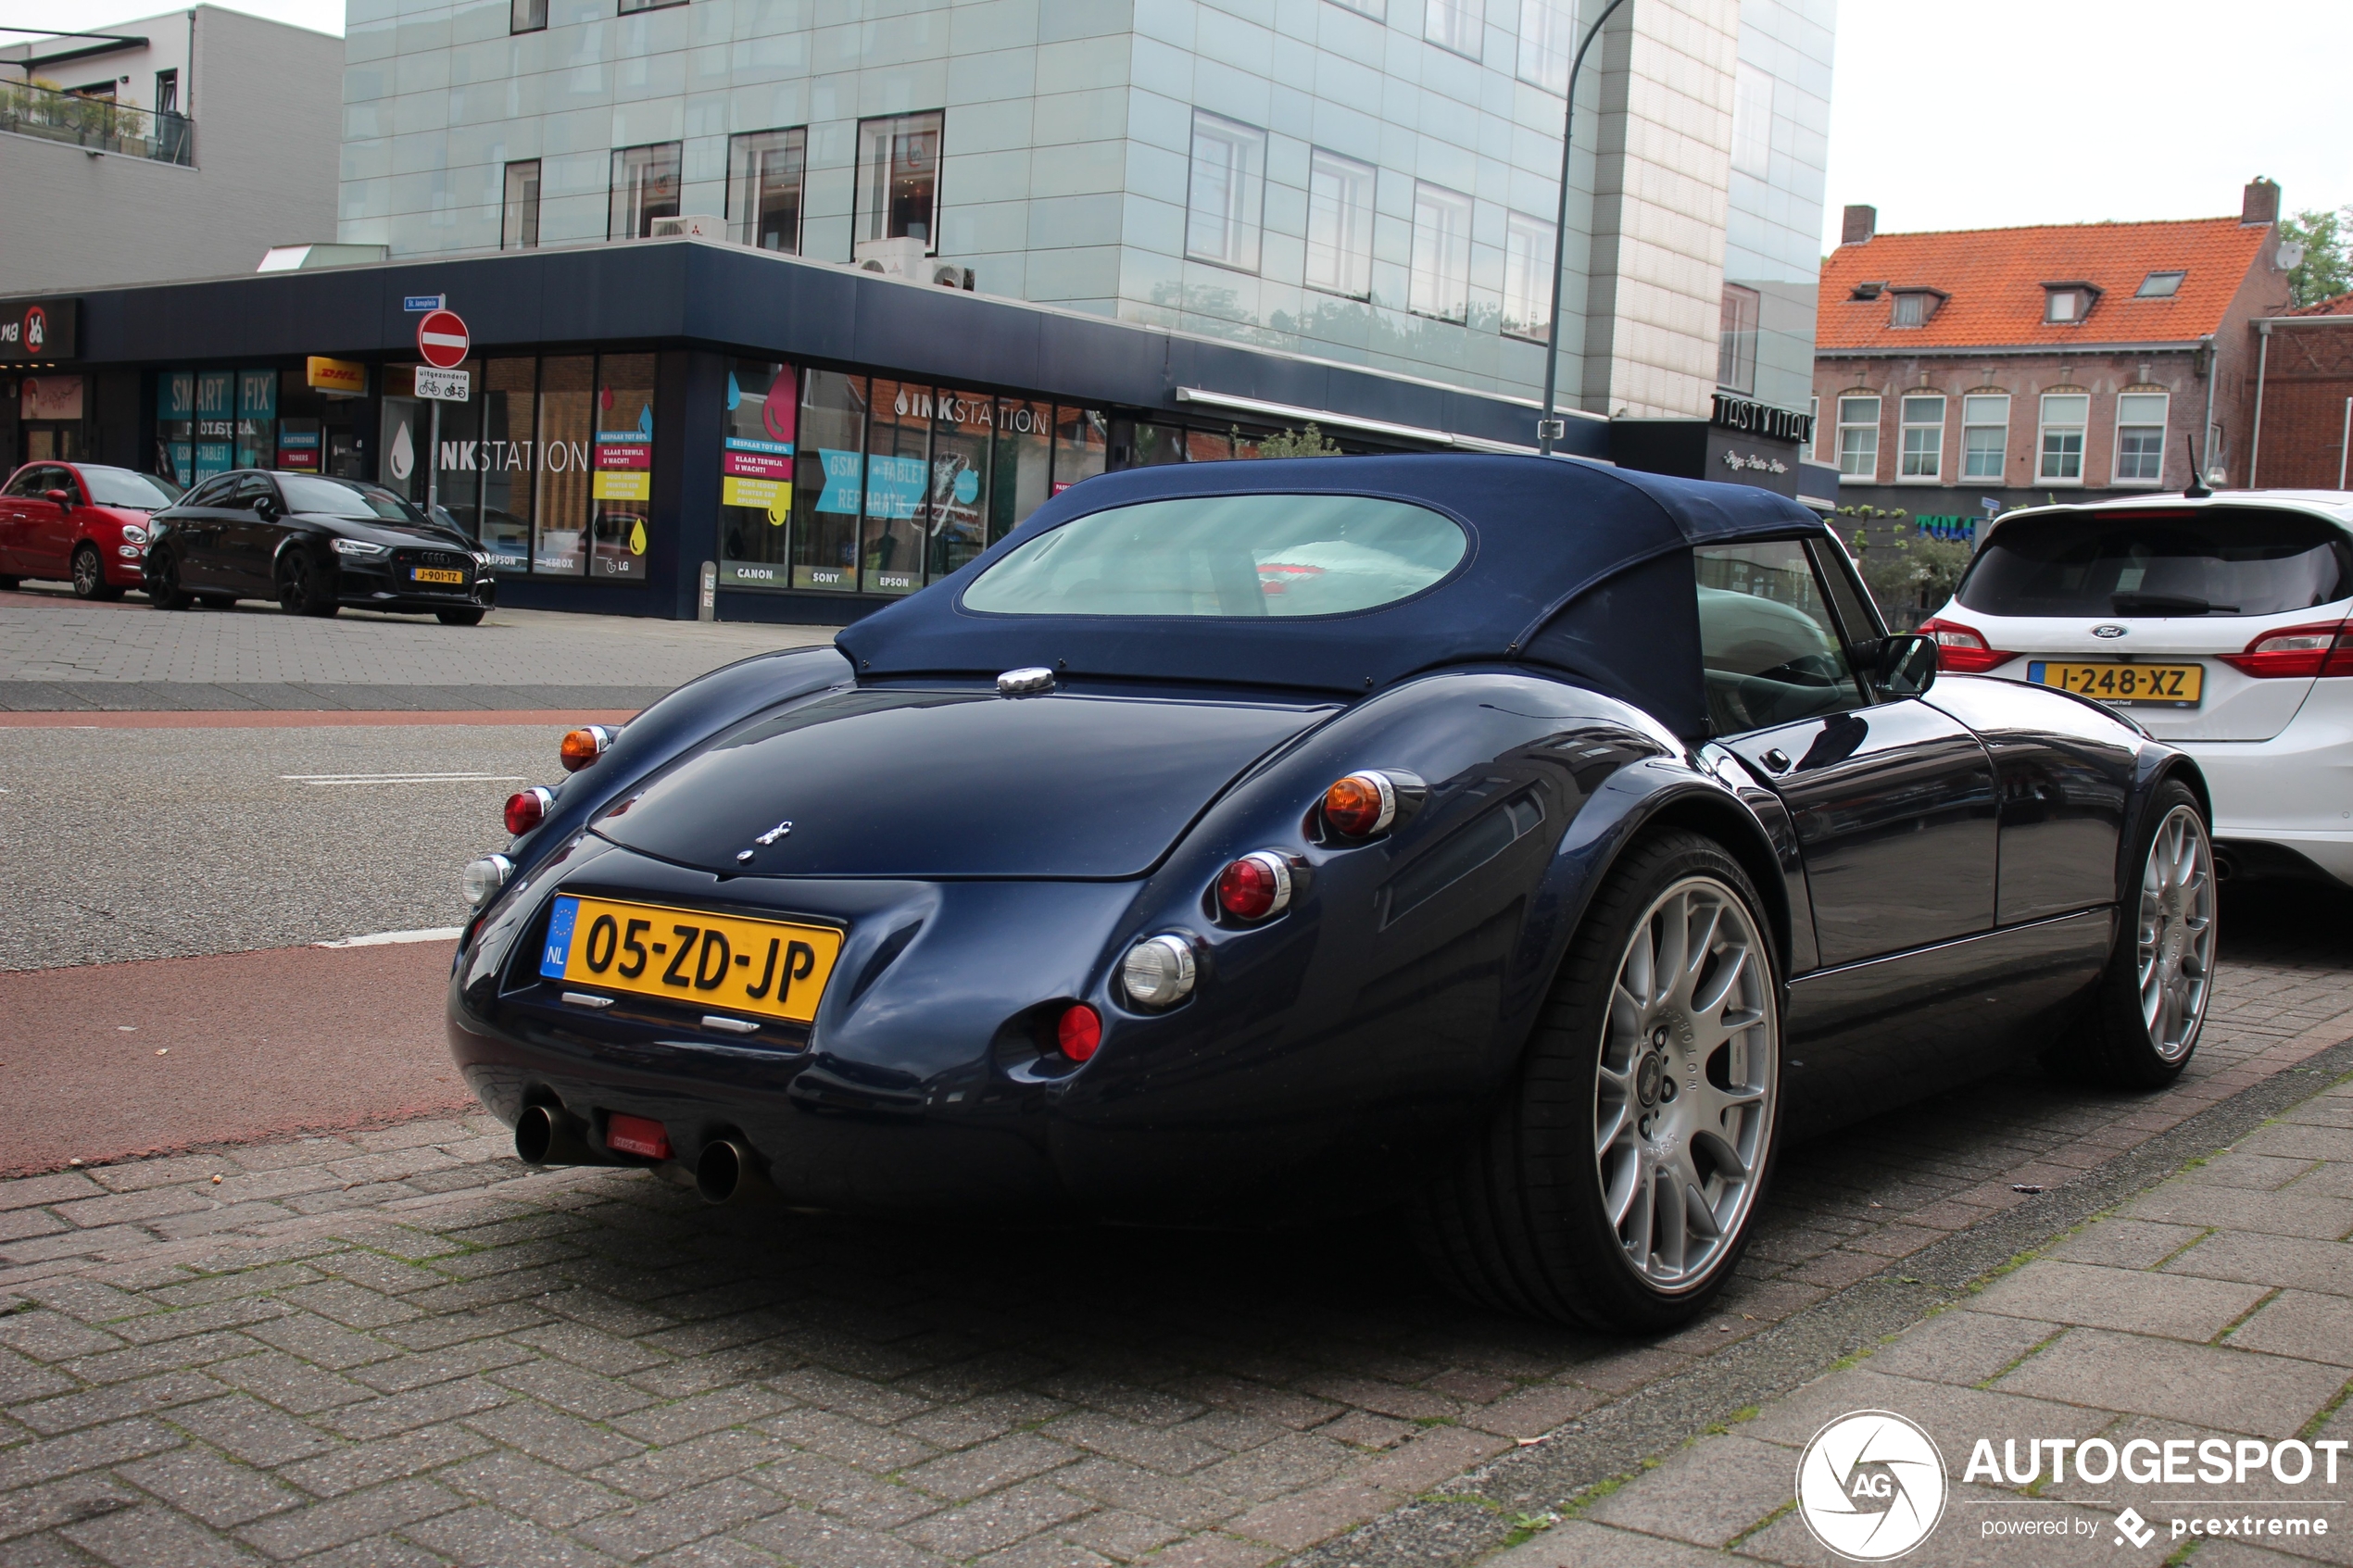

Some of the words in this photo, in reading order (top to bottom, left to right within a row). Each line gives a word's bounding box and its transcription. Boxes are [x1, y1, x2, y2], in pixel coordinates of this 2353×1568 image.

[321, 368, 358, 381] DHL
[419, 370, 467, 381] uitgezonderd
[171, 378, 225, 411] SMART
[912, 393, 1047, 435] INKSTATION
[1718, 395, 1772, 433] TASTY
[1775, 409, 1816, 443] ITALY
[732, 439, 760, 448] BESPAAR
[761, 443, 774, 451] TOT
[201, 445, 226, 461] TABLET
[288, 454, 308, 462] TONERS
[735, 455, 756, 464] KLAAR
[757, 458, 783, 467] TERWIJL
[740, 464, 766, 473] WACHT!
[830, 455, 859, 478] GSM
[883, 461, 926, 484] TABLET
[757, 482, 778, 490] IEDERE
[736, 488, 763, 497] PRINTER
[736, 497, 772, 506] OPLOSSING
[837, 487, 907, 514] REPARATIE
[545, 558, 573, 569] XEROX
[618, 560, 629, 571] LG
[420, 570, 458, 582] J-901-TZ
[736, 568, 773, 580] CANON
[812, 572, 840, 583] SONY
[879, 577, 909, 587] EPSON
[2097, 626, 2120, 637] Ford
[546, 946, 564, 965] NL
[585, 913, 815, 1003] 05-ZD-JP
